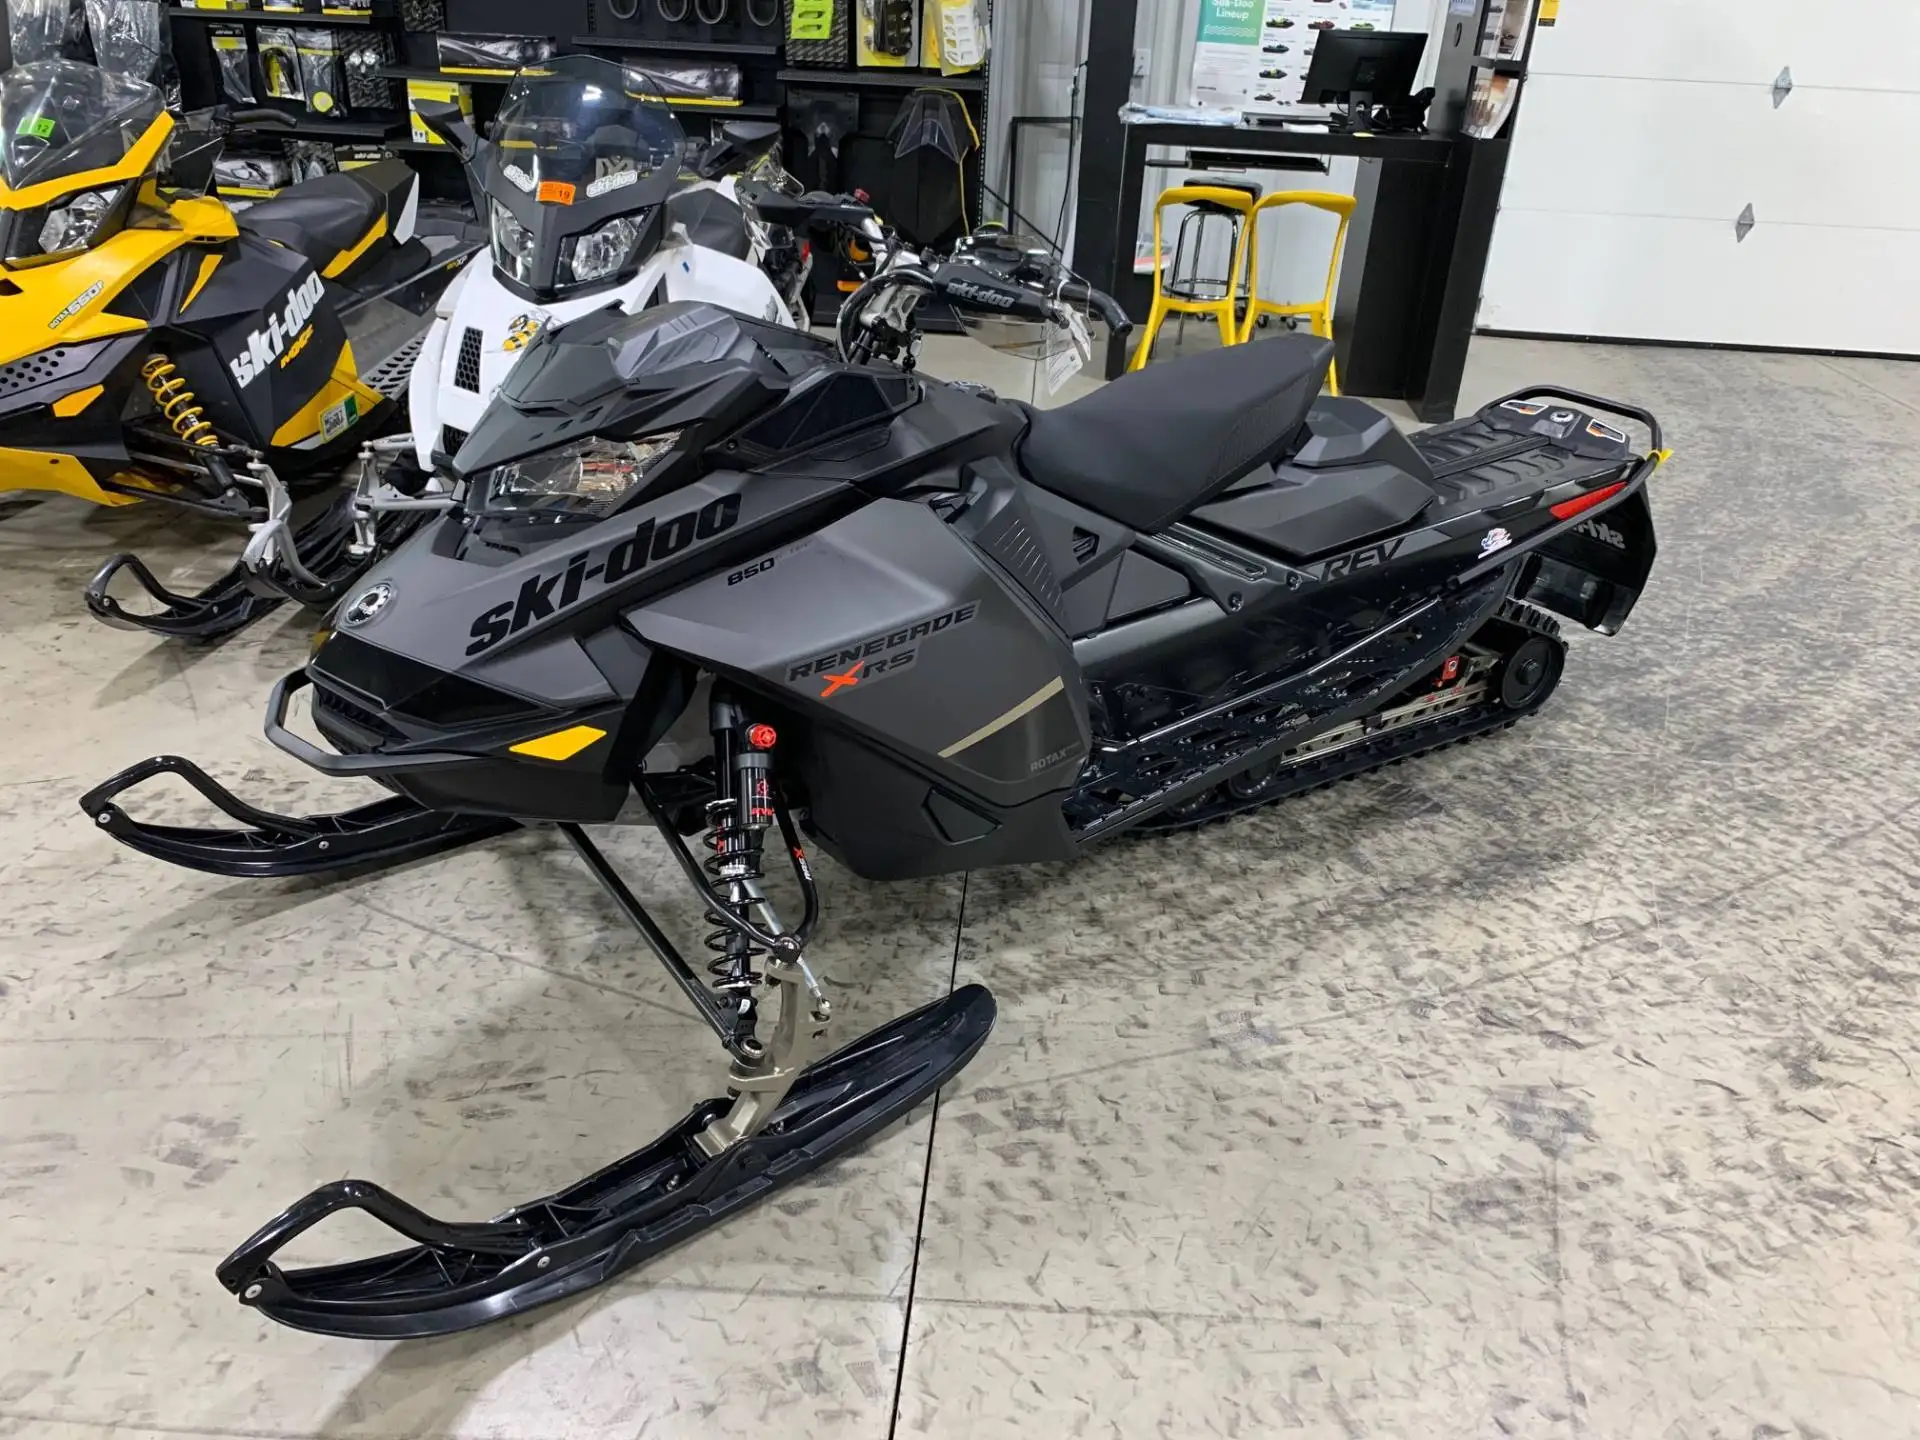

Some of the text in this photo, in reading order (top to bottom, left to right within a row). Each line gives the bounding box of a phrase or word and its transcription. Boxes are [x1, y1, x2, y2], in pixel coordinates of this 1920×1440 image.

[1216, 7, 1249, 21] Lineup
[558, 190, 570, 199] 19
[947, 280, 1016, 308] ski-doo
[229, 270, 325, 389] ski-doo
[727, 557, 775, 586] 850
[1320, 536, 1406, 583] REV
[465, 492, 742, 657] ski-doo
[789, 603, 977, 682] RENEGADE
[1030, 749, 1068, 773] ROTAX
